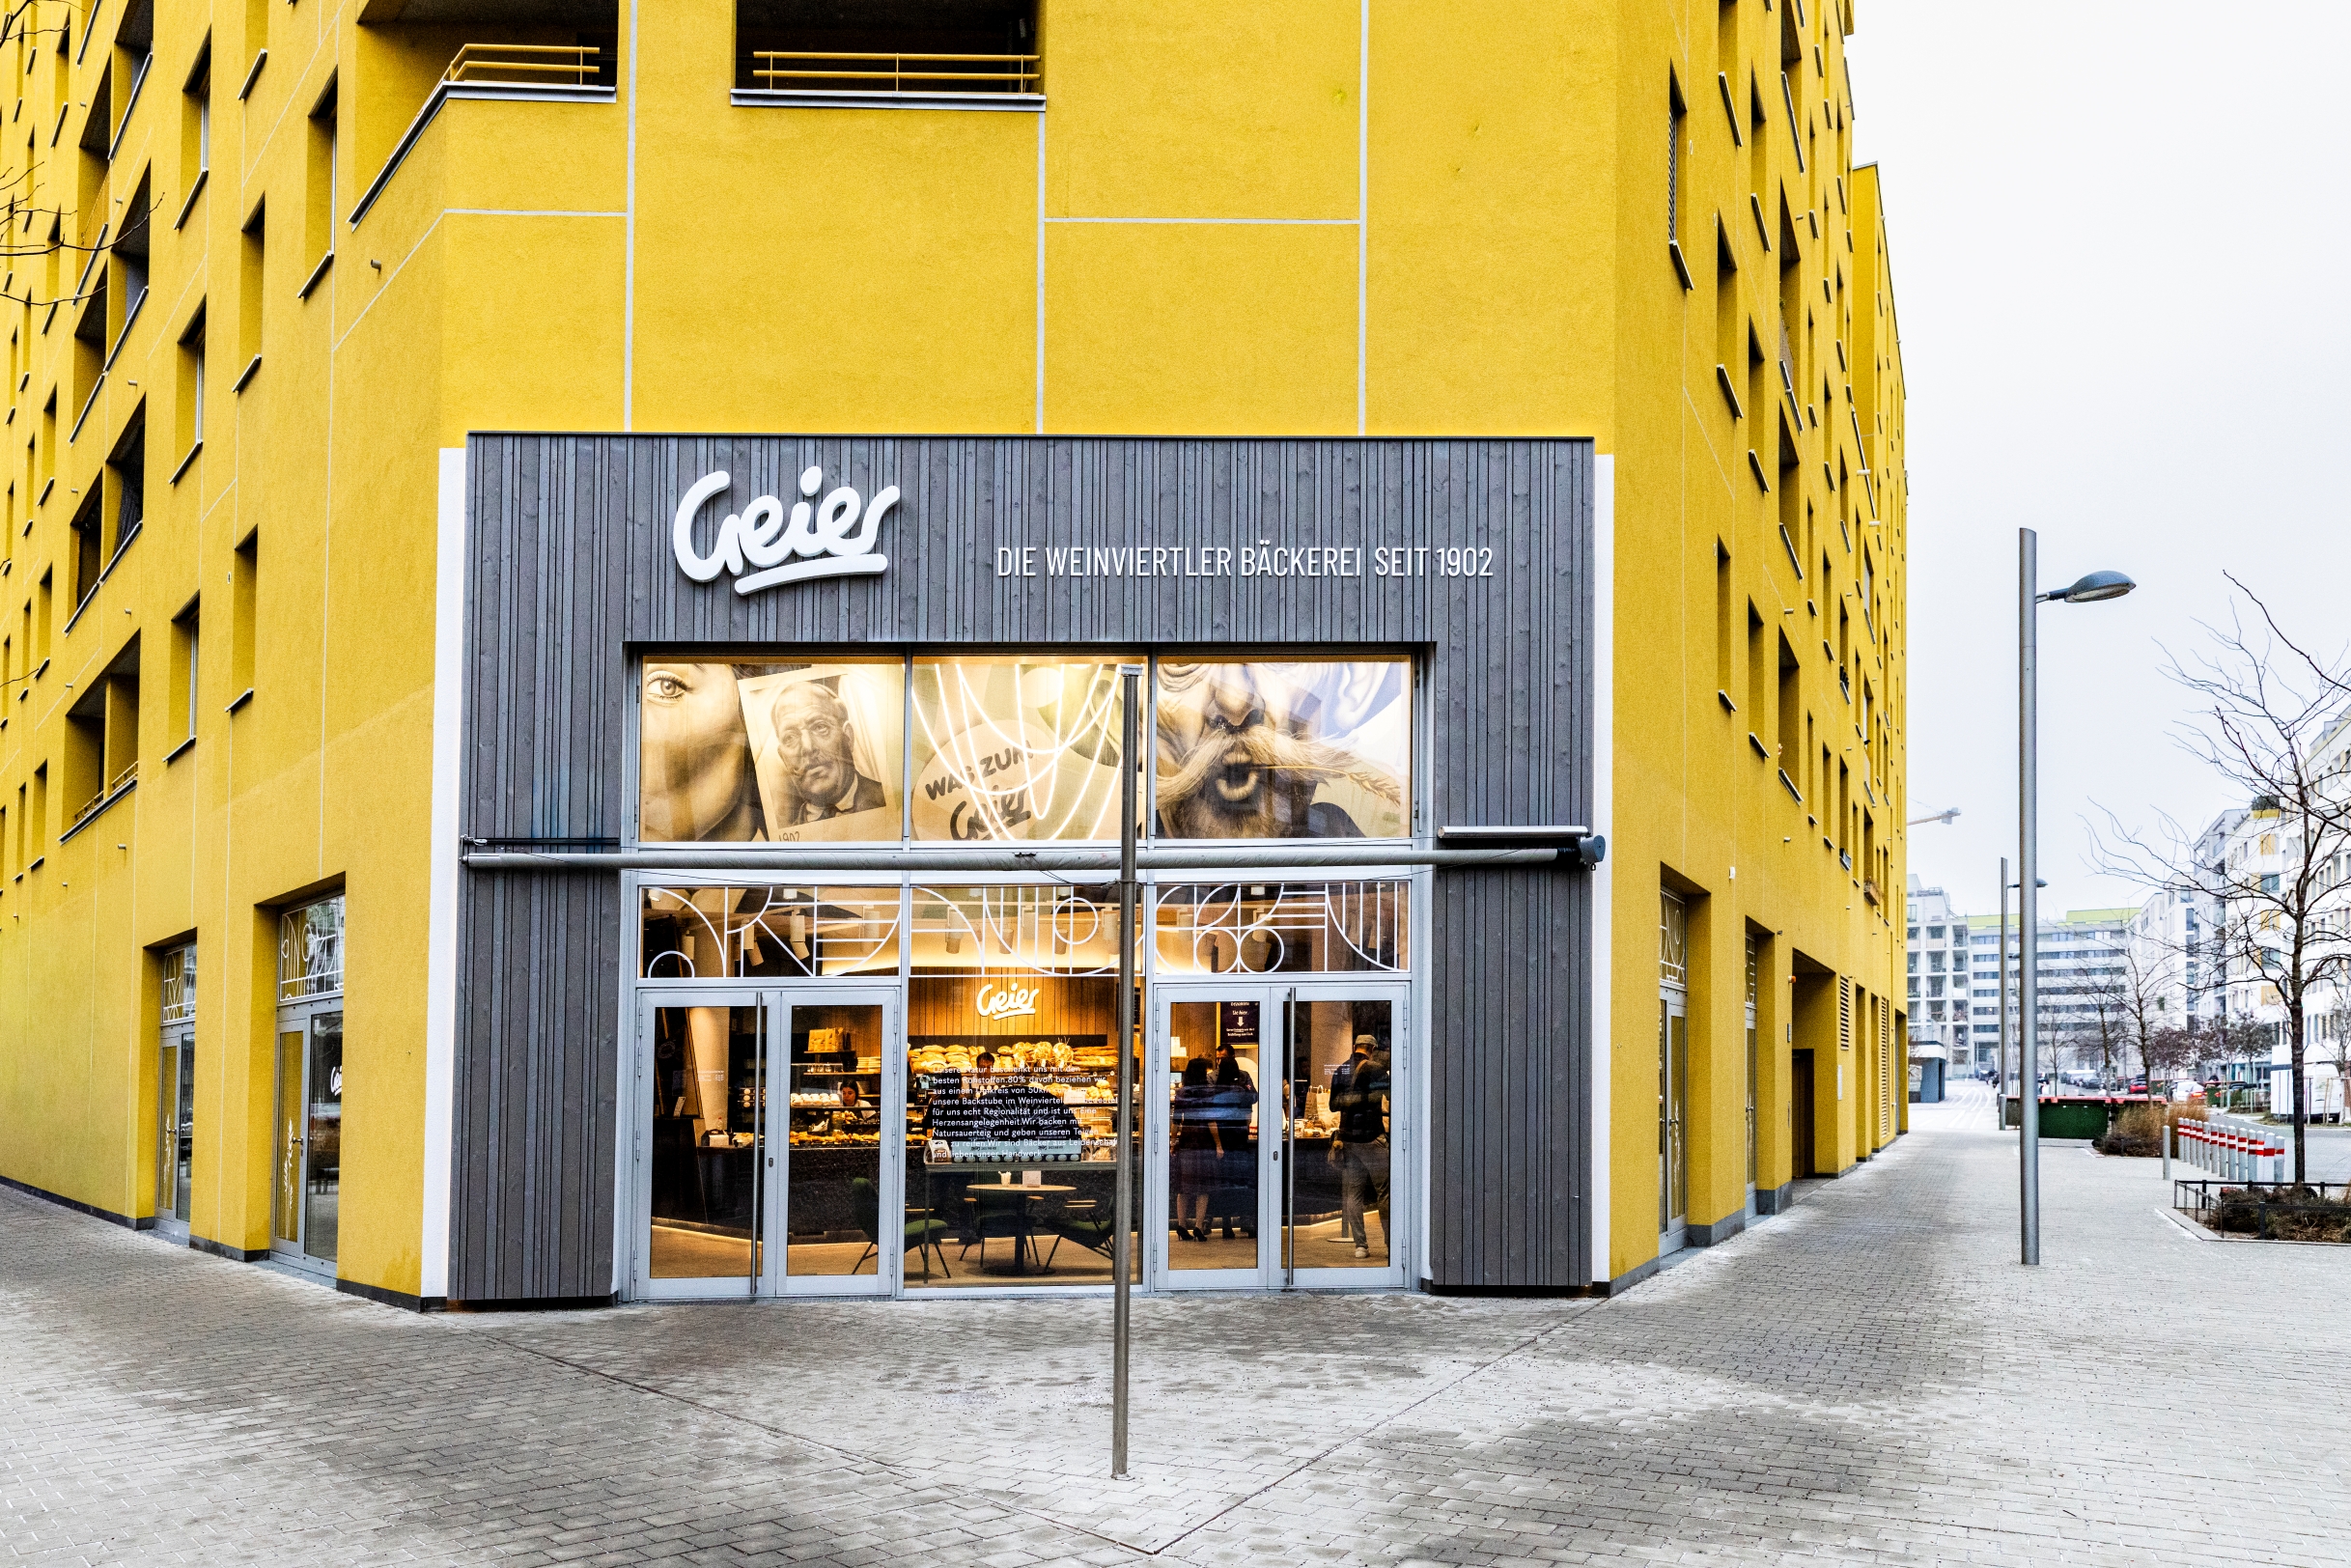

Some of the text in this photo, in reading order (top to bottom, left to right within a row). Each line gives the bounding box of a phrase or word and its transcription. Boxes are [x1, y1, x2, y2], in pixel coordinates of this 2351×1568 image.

[673, 465, 901, 596] Geier
[997, 539, 1494, 576] DIE WEINVIERTLER BÄCKEREI SEIT 1902
[925, 740, 1033, 800] WAS ZUM
[977, 983, 1039, 1020] Geier
[983, 1106, 1030, 1116] Regionalität
[932, 1128, 992, 1137] Natursauerteig
[1011, 1128, 1036, 1137] geben
